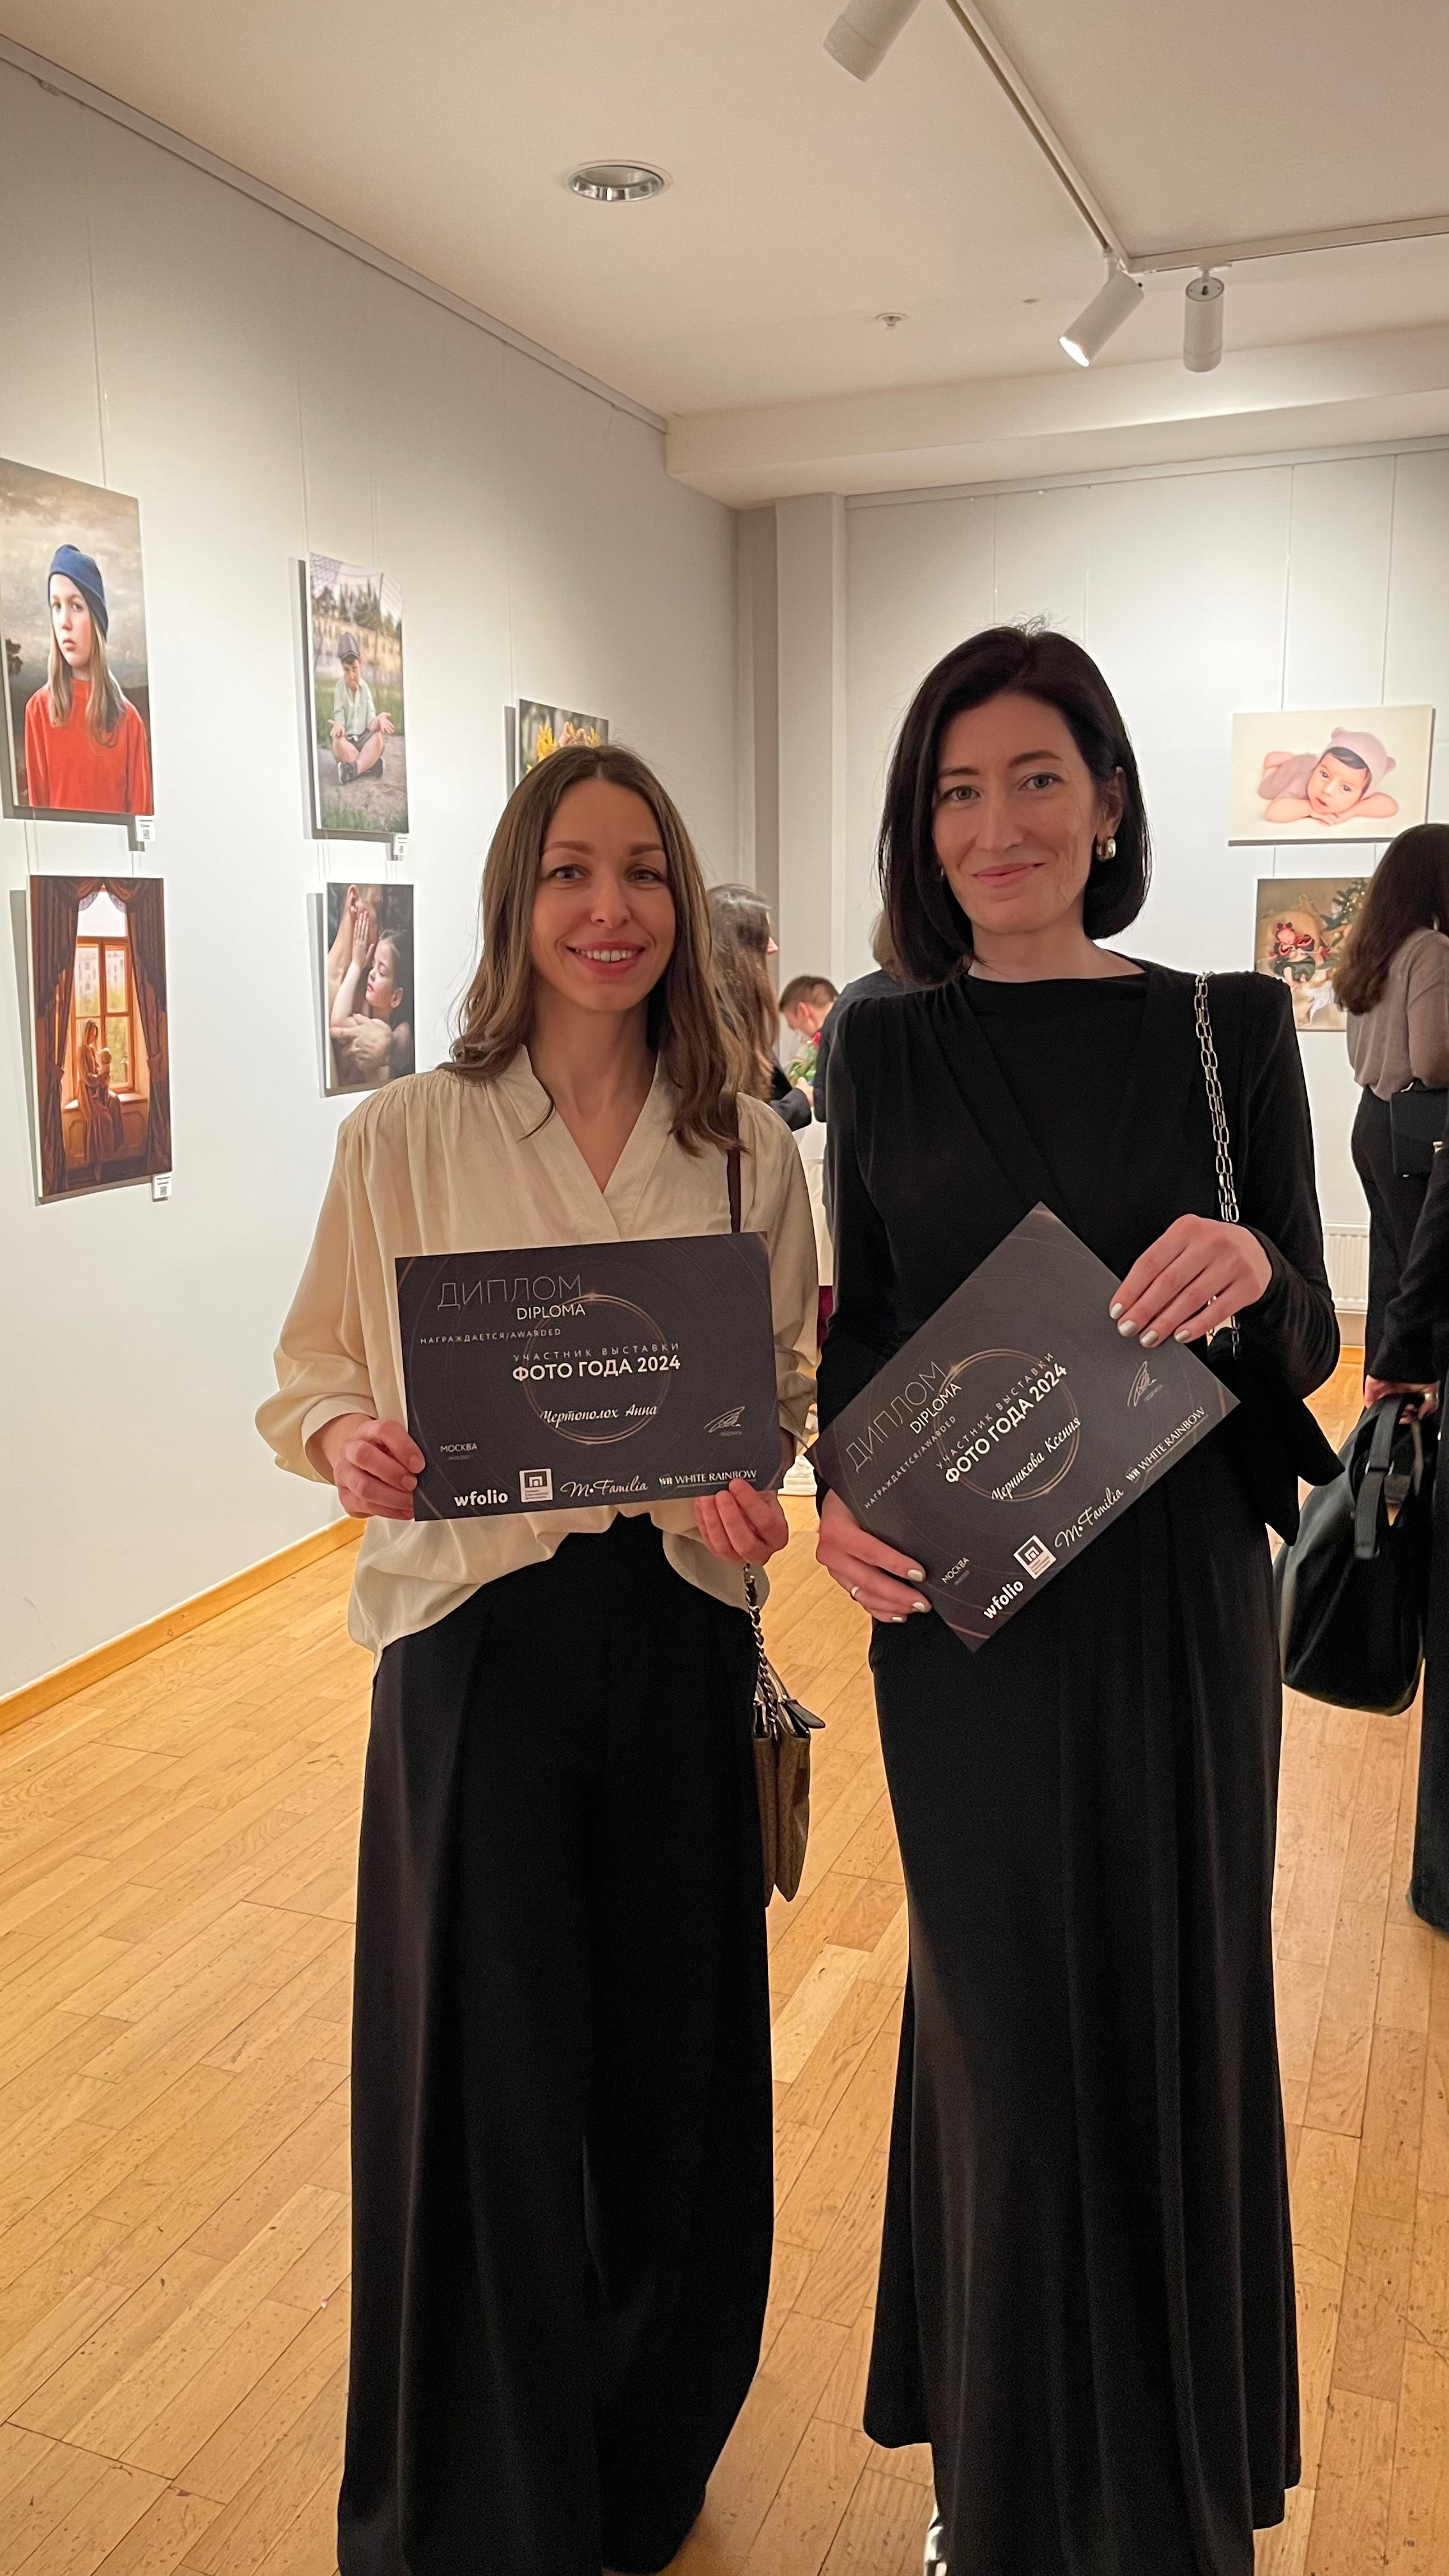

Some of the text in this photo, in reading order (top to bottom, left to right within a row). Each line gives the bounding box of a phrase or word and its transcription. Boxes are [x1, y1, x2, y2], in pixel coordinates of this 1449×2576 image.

[437, 1275, 581, 1311] ДИПЛОМ
[516, 1304, 586, 1320] DIPLOMA
[512, 1343, 679, 1362] УЧАСТНИК ВЫСТАВКИ
[512, 1354, 681, 1381] ФОТО ГОДА 2024
[625, 1404, 657, 1418] Анна
[846, 1361, 947, 1474] ДИПЛОМ
[909, 1383, 962, 1434] DIPLOMA
[936, 1353, 1054, 1469] УЧАСТНИК ВЫСТАВКИ
[946, 1363, 1067, 1483] ФОТО ГОДА 2024
[440, 1443, 478, 1453] МОСКВА
[1044, 1417, 1081, 1453] Ксения
[1137, 1443, 1167, 1471] WHITE
[1164, 1406, 1206, 1447] RAINBOW
[675, 1473, 707, 1484] WHITE
[454, 1489, 509, 1507] wfolio
[941, 1557, 970, 1584] МОСКВА
[983, 1581, 1024, 1619] wfolio
